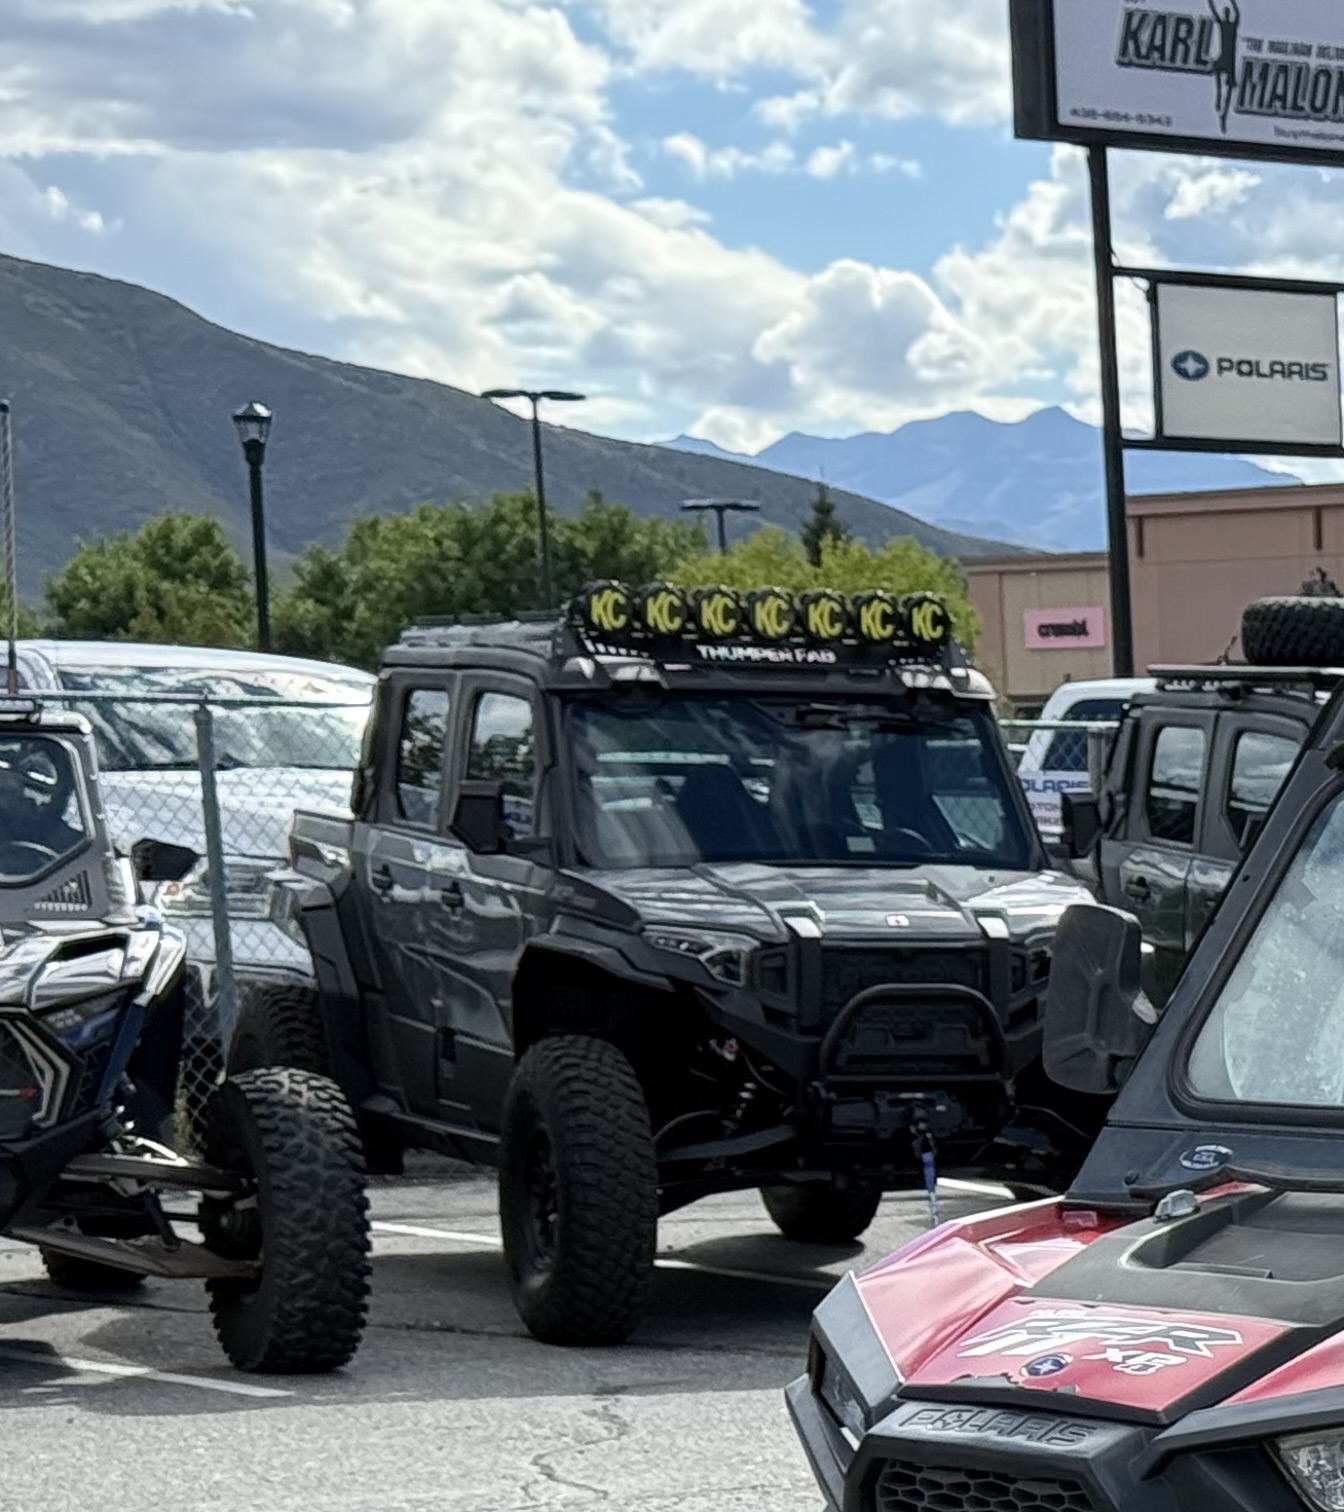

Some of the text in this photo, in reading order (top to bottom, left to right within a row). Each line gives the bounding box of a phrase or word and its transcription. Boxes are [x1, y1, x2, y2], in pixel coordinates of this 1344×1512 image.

[1119, 9, 1213, 72] KARL
[1216, 357, 1329, 382] POLARIS
[590, 589, 627, 631] KC
[646, 590, 683, 633] KC
[701, 594, 737, 637] KC
[754, 595, 791, 639] KC
[807, 598, 844, 640] KC
[859, 600, 896, 641] KC
[911, 601, 944, 642] KC
[696, 644, 794, 663] THUMPER
[898, 1408, 1097, 1445] POLARIS
